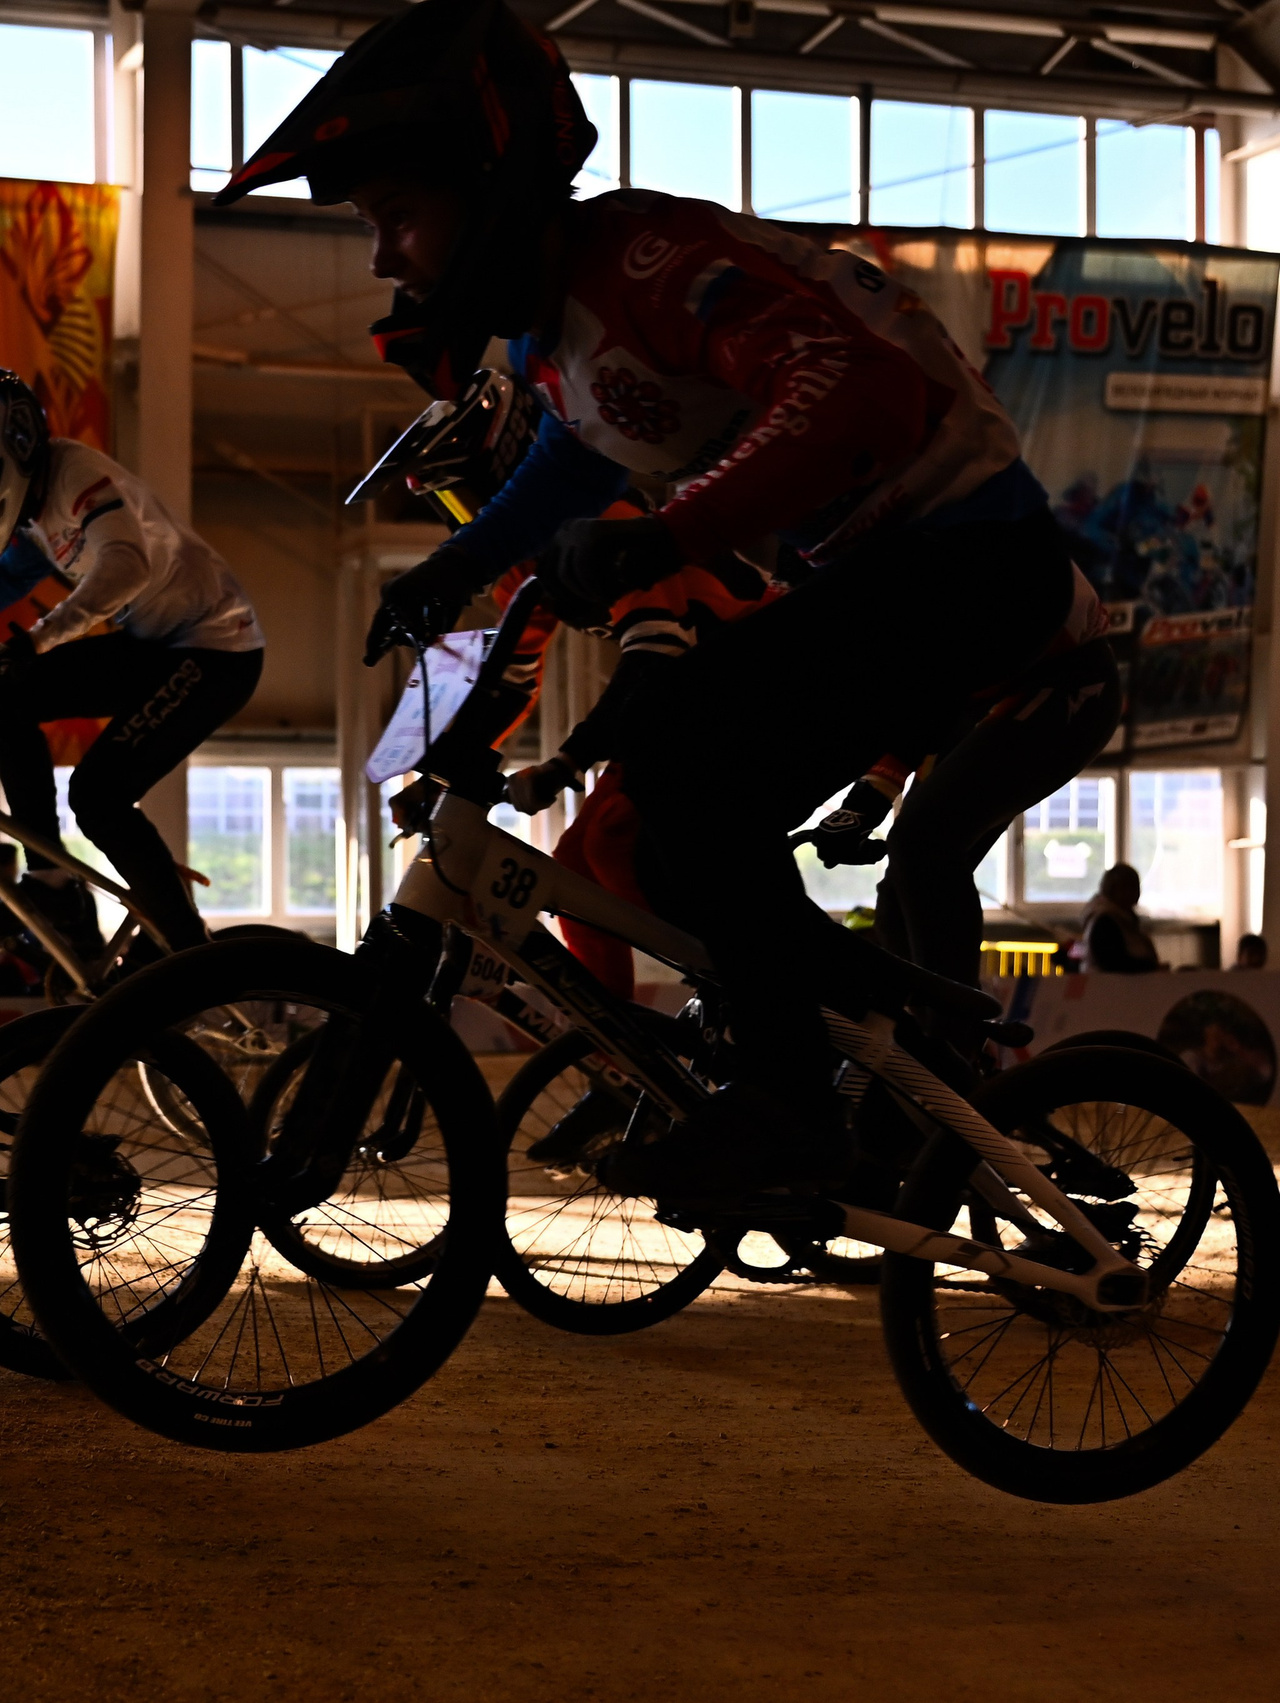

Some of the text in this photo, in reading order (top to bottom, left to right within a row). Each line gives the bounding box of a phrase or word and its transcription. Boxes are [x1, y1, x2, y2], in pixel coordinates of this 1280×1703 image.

[986, 270, 1264, 355] Provelo
[492, 858, 537, 909] 38
[470, 953, 505, 985] 504
[518, 1005, 629, 1088] MEBO
[134, 1357, 286, 1408] FORWARD
[211, 1416, 233, 1426] TIRE
